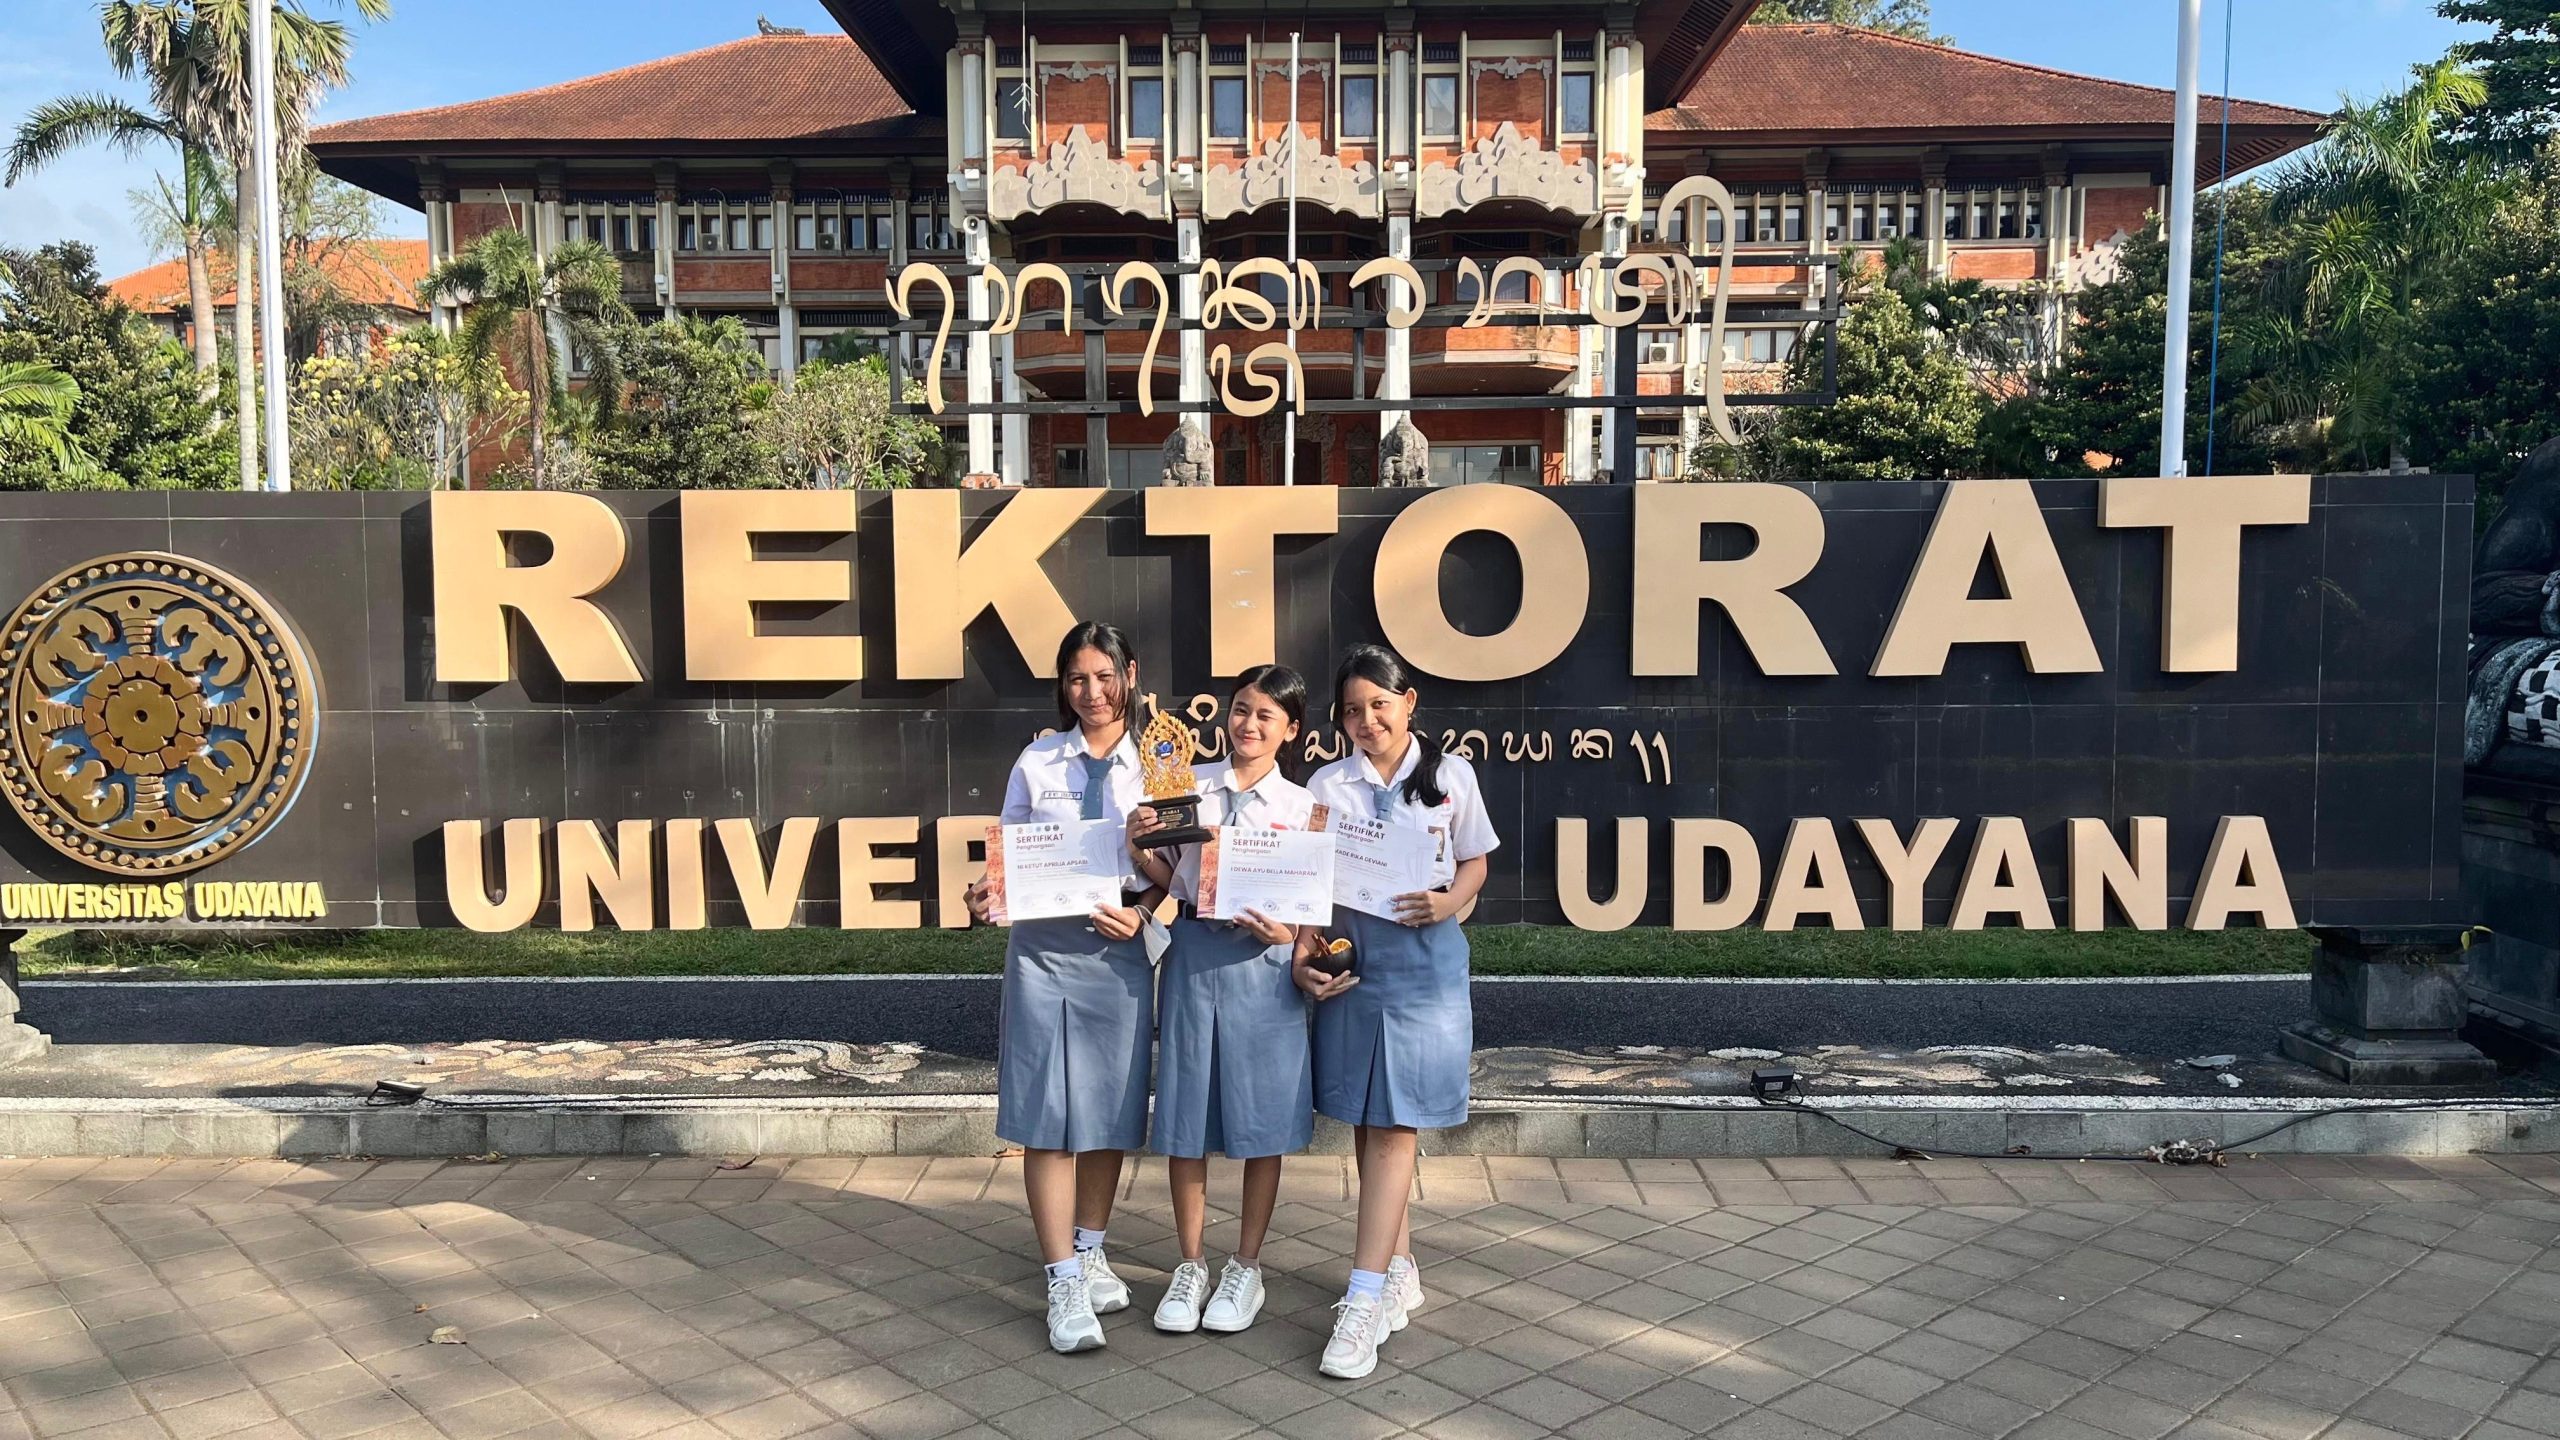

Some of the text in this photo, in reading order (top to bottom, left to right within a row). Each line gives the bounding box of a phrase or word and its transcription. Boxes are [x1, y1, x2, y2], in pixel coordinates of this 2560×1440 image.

[431, 474, 2311, 684] REKTORAT
[1016, 833, 1065, 844] SERTIFIKAT
[1232, 838, 1282, 848] SERTIFIKAT
[1338, 821, 1386, 841] SERTIFIKAT
[1554, 815, 2299, 932] UDAYANA
[1, 881, 327, 919] UNIVERSITAS UDAYANA
